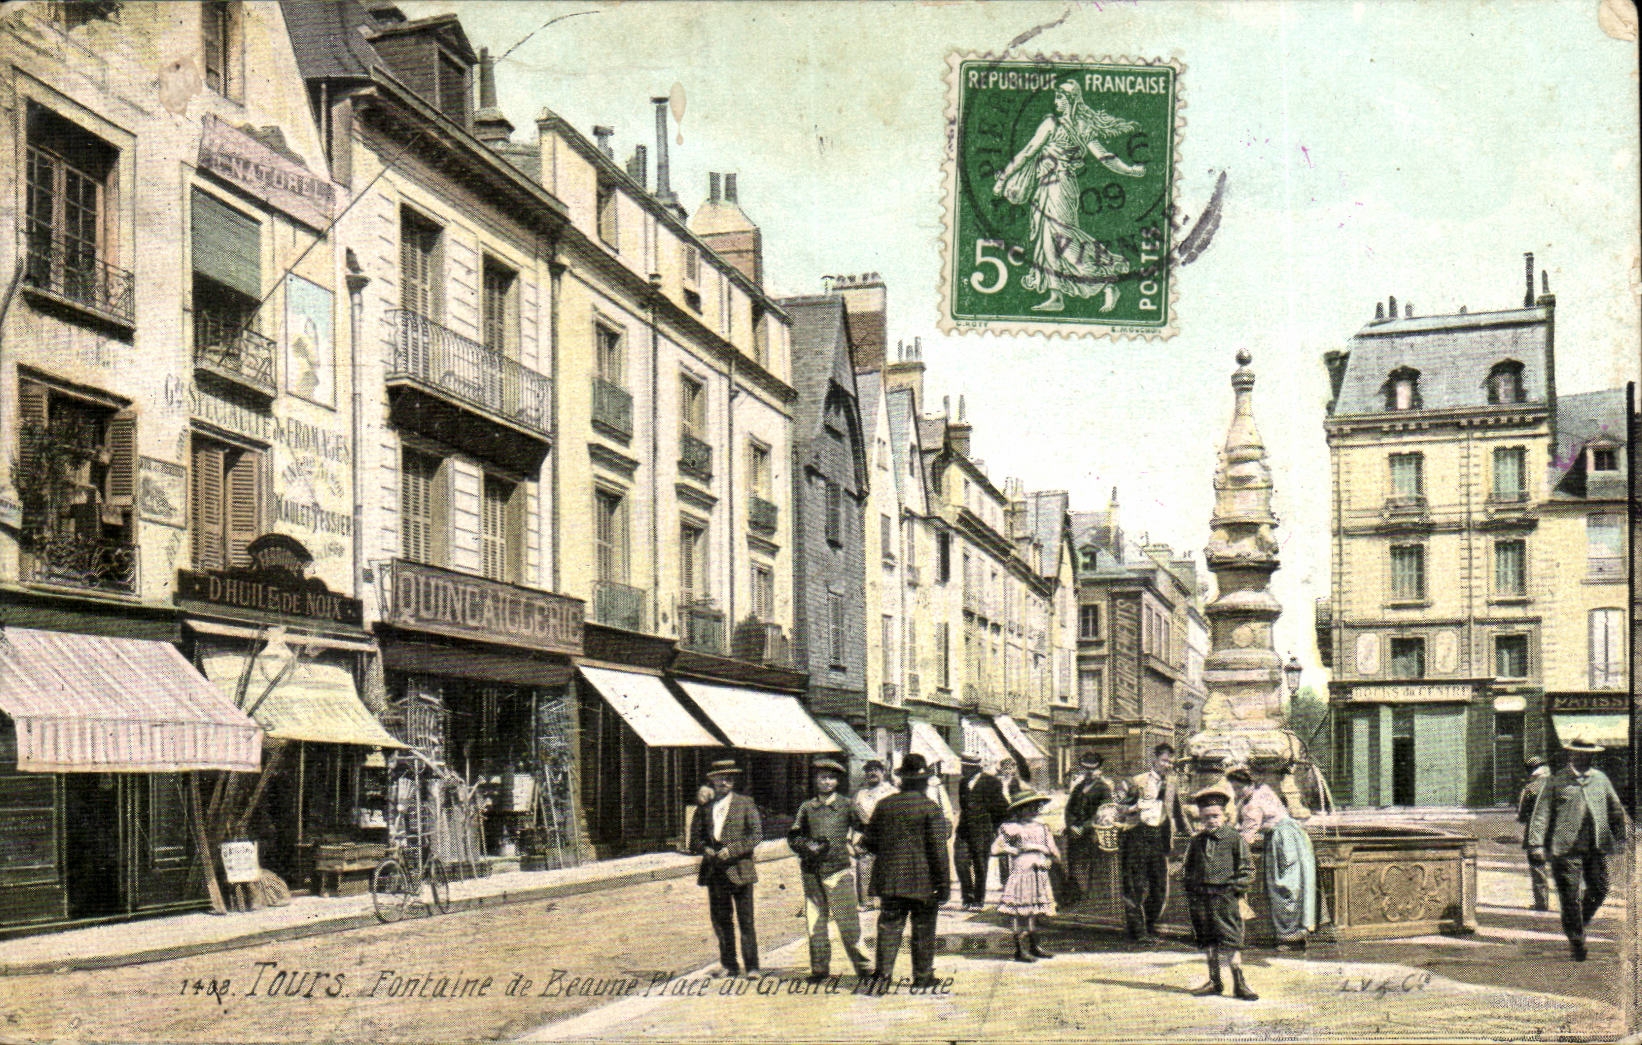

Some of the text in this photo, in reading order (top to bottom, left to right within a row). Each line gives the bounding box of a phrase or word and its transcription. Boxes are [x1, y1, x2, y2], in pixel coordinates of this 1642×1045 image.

[1085, 74, 1167, 95] FRANÇAISE
[1138, 227, 1161, 311] POSTES
[282, 592, 302, 614] DE
[304, 592, 343, 620] NOIX
[399, 571, 582, 643] QUINCAILLERIE
